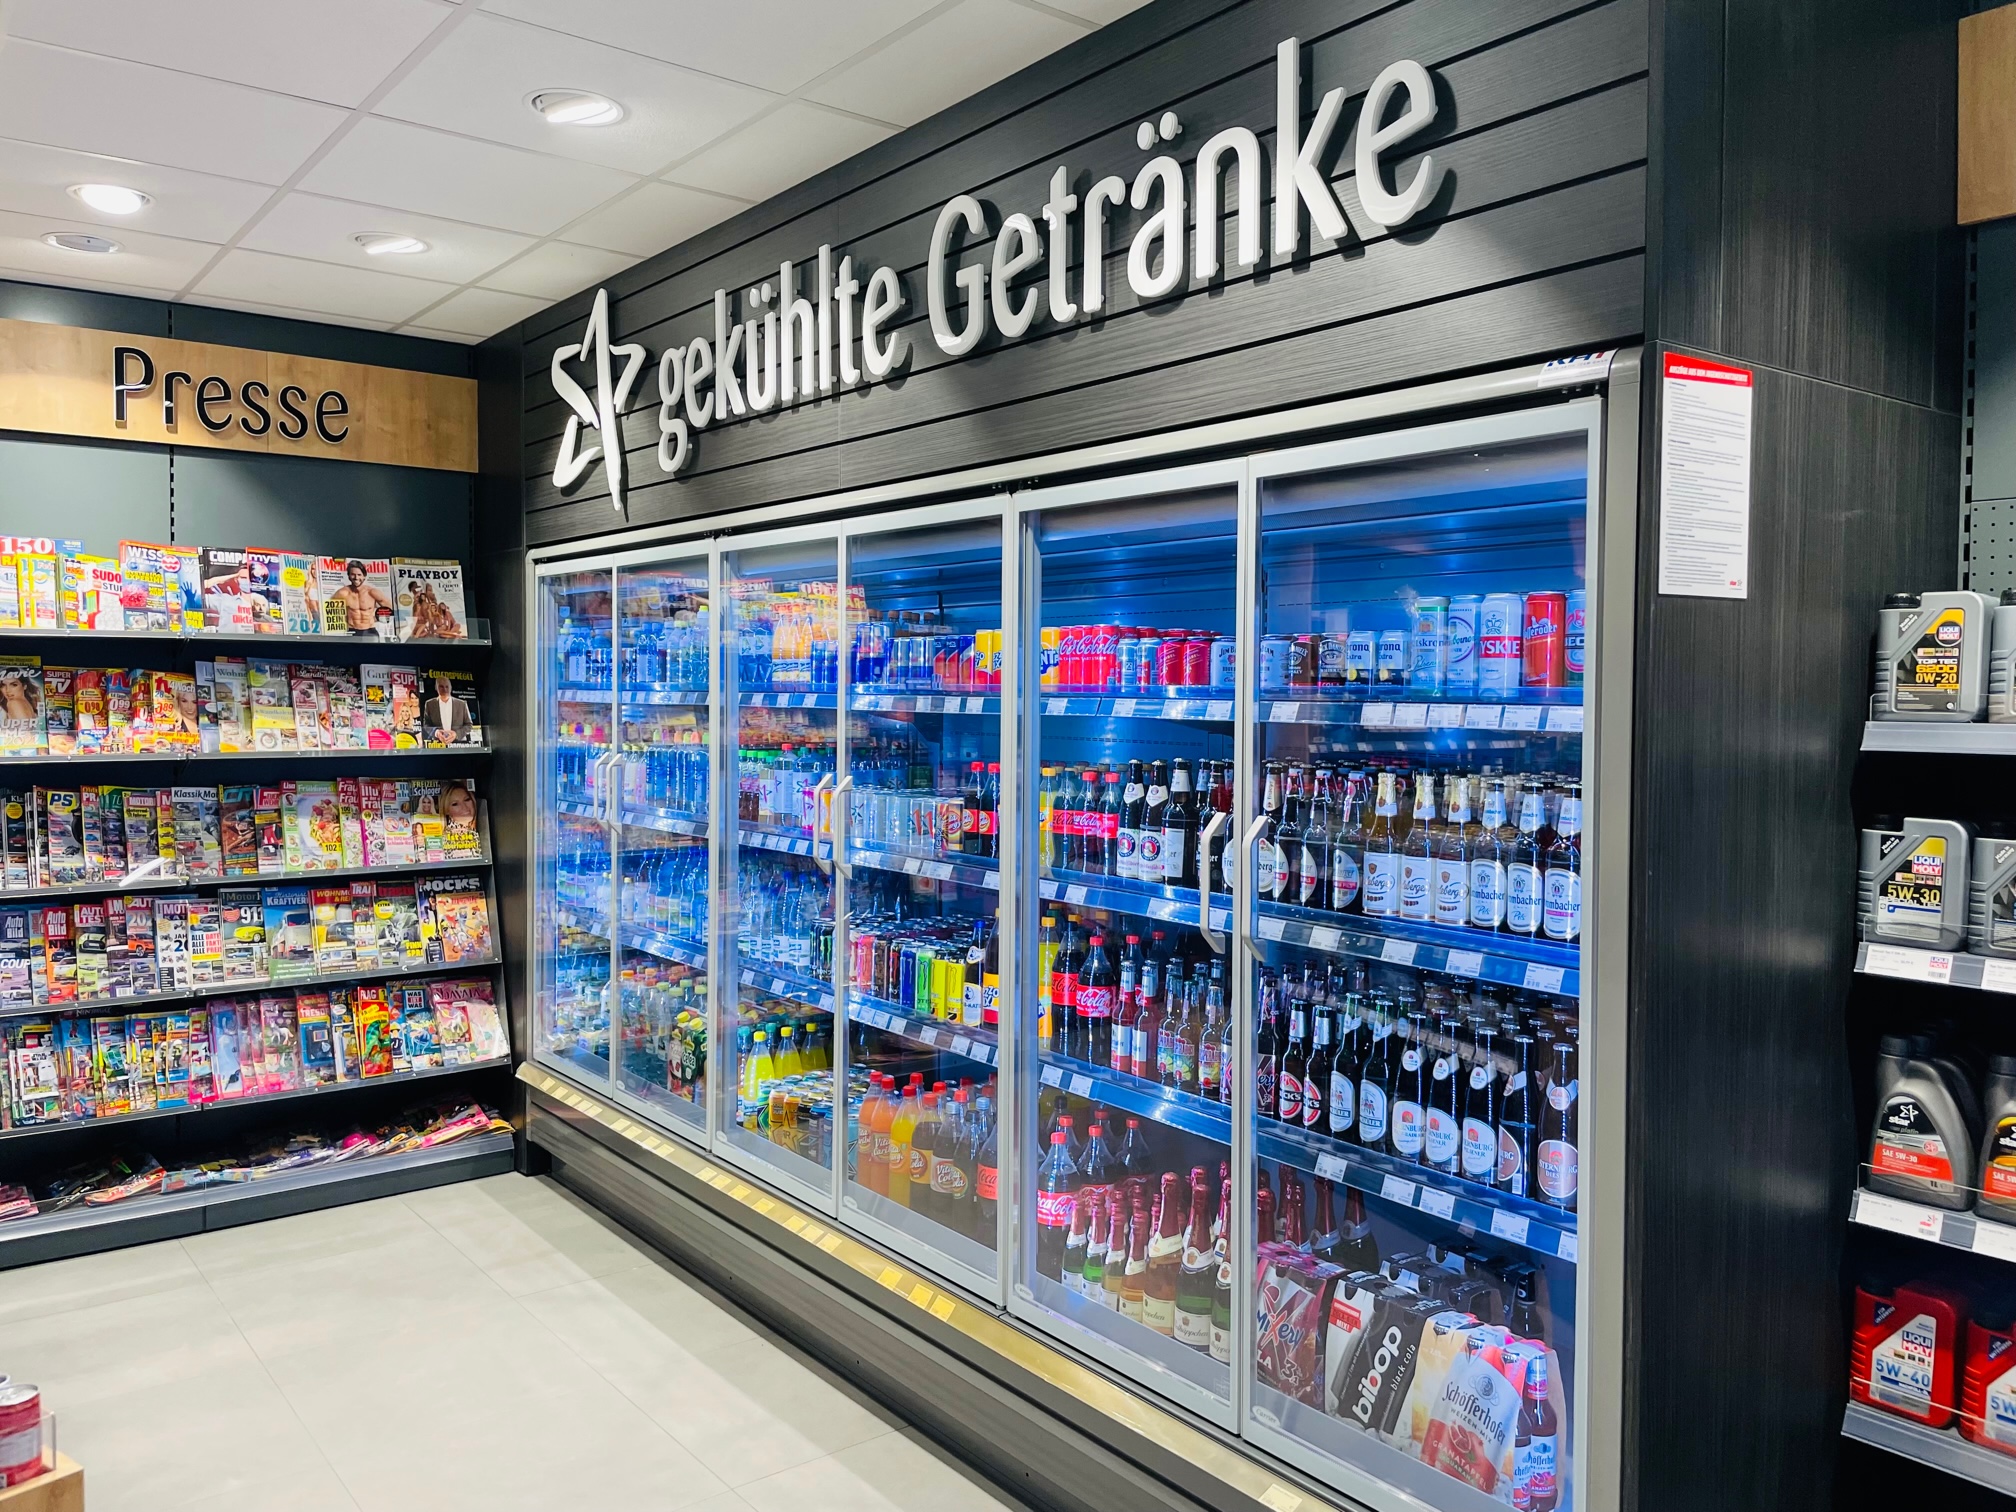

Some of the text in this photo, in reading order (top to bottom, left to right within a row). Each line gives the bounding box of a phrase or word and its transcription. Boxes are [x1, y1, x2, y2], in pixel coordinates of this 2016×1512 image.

[658, 36, 1437, 473] gekühlte Getränke
[112, 345, 349, 444] Presse
[398, 569, 459, 580] PLAYBOY
[325, 601, 345, 609] 2022
[326, 608, 346, 616] WIRD
[326, 616, 344, 624] DEIN
[327, 623, 347, 631] JAHR
[46, 671, 71, 679] SUPER
[1915, 665, 1958, 673] 6200
[1915, 673, 1957, 684] 0W-20
[50, 793, 74, 807] PS
[325, 843, 338, 852] 102
[1914, 855, 1942, 866] LIQUI
[1913, 864, 1942, 875] MOLY
[1887, 885, 1941, 904] 5W-30
[46, 911, 67, 925] Auto
[48, 924, 67, 936] Bild
[1888, 1115, 1911, 1127] star
[1881, 1148, 1918, 1163] SAE 5W-30
[1992, 1171, 2004, 1180] SAE
[1903, 1331, 1933, 1347] LIQUI
[1902, 1340, 1932, 1358] MOLY
[1389, 1343, 1417, 1392] black cola
[1875, 1358, 1932, 1389] 5W-40
[1351, 1325, 1403, 1424] bibop
[1441, 1380, 1506, 1445] Schöfferhofer
[1432, 1439, 1488, 1491] GRANATAPFEL
